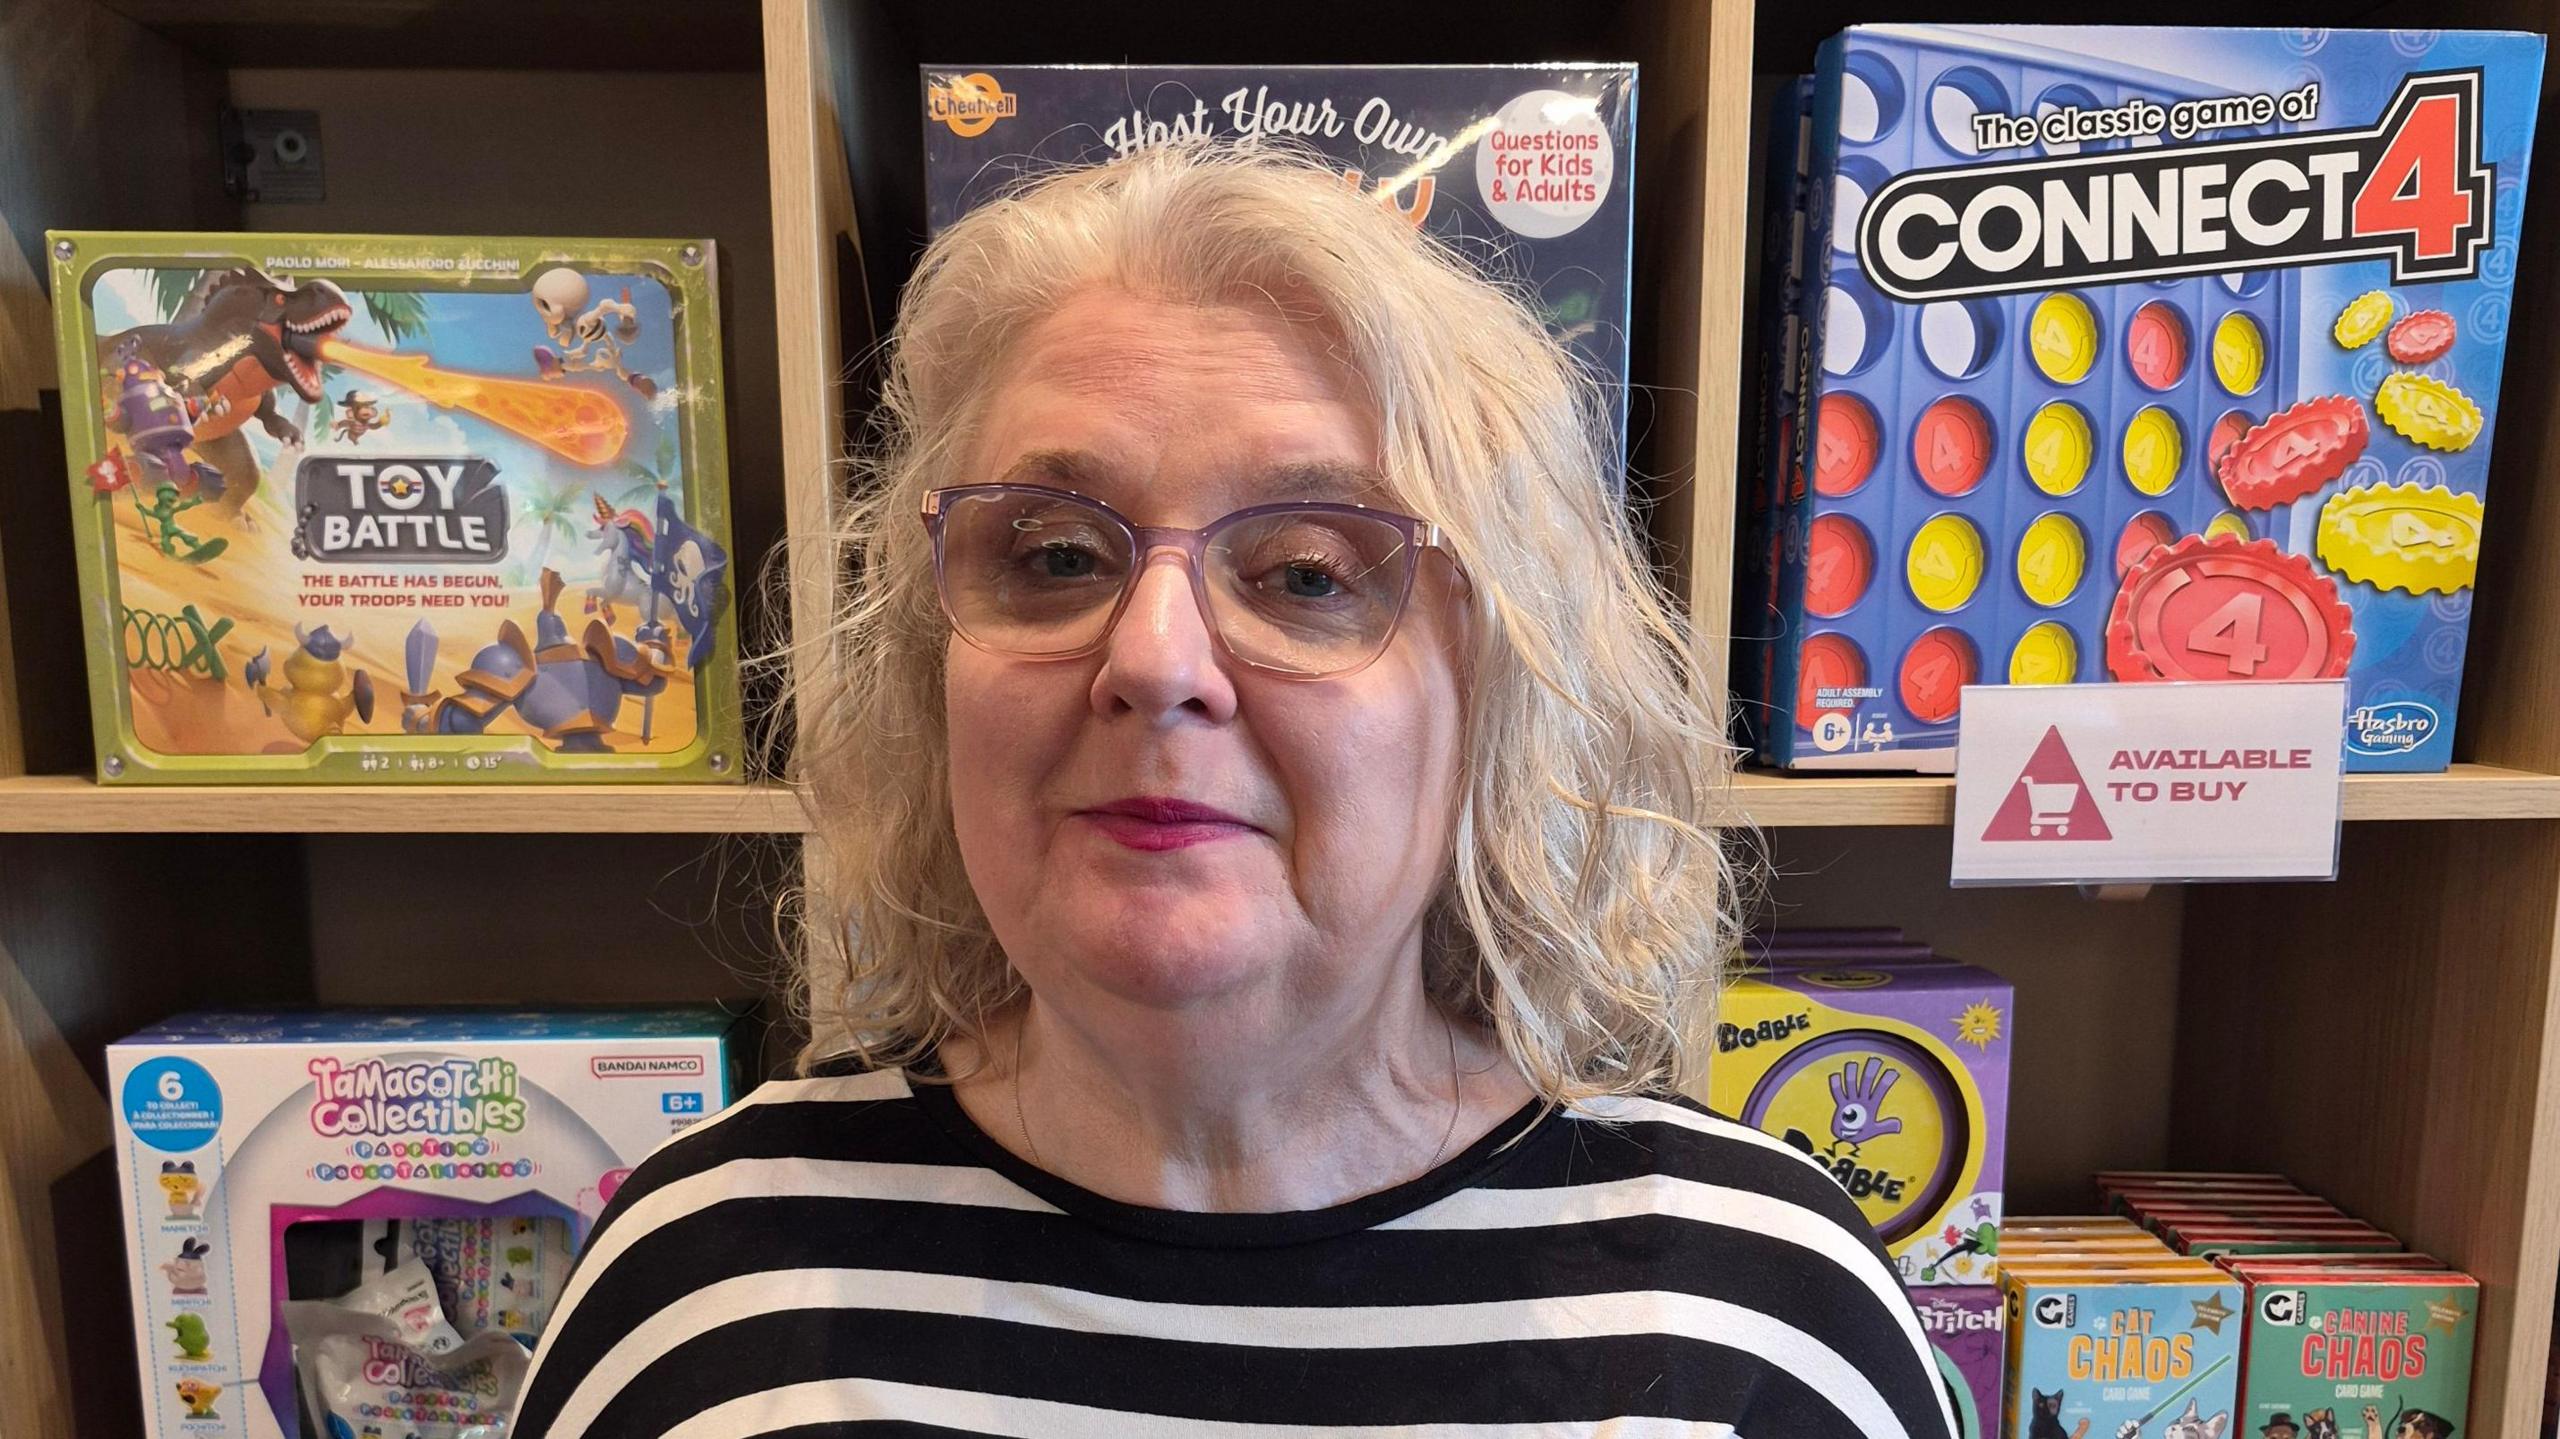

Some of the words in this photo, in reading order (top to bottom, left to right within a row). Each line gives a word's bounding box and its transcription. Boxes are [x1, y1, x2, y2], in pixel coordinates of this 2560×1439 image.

[934, 96, 1014, 116] Cheatwell
[1974, 113, 2037, 150] The
[2042, 100, 2166, 144] classic
[2170, 94, 2275, 140] game
[2278, 83, 2319, 120] of
[1105, 99, 1213, 162] Host
[1221, 85, 1345, 152] Your
[1353, 97, 1450, 160] Own
[1491, 130, 1599, 151] Questions
[1495, 154, 1533, 176] for
[1540, 153, 1593, 176] Kids
[1492, 179, 1508, 202] &
[1516, 179, 1596, 202] Adults
[1878, 151, 2360, 281] CONNECT
[2352, 93, 2472, 260] 4
[266, 257, 312, 269] PAOLO
[363, 258, 452, 271] ALESSANDRO
[458, 258, 520, 272] ZUCCHINI
[336, 464, 465, 511] TOY
[322, 514, 492, 552] BATTLE
[302, 575, 334, 588] THE
[338, 575, 399, 588] BATTLE
[404, 575, 438, 588] HAS
[443, 575, 504, 589] BEGUN,
[298, 594, 345, 607] YOUR
[349, 594, 417, 607] TROOPS
[421, 594, 465, 607] NEED
[471, 594, 510, 608] YOU!
[1816, 688, 1841, 698] ADULT
[1842, 688, 1883, 698] ASSEMBLY
[1823, 722, 1846, 741] 6+
[2357, 710, 2429, 735] Hasbro
[2360, 729, 2415, 749] Gaming
[2108, 749, 2313, 770] AVAILABLE
[2107, 782, 2159, 802] TO
[2169, 781, 2248, 802] BUY
[1716, 1012, 1811, 1054] DOBBLE
[598, 1061, 647, 1072] BANDAI
[649, 1060, 698, 1071] NAMCO
[158, 1070, 184, 1101] 6
[669, 1095, 697, 1111] 6+
[311, 1098, 527, 1138] Collectibles
[2066, 1295, 2076, 1328] GAMES
[2296, 1292, 2306, 1324] GAMES
[2111, 1307, 2154, 1337] CAT
[2323, 1308, 2408, 1336] CANINE
[2068, 1332, 2194, 1384] CHAOS
[2301, 1333, 2426, 1382] CHAOS
[2103, 1387, 2125, 1401] CARD
[2127, 1386, 2152, 1401] GAME
[2335, 1384, 2358, 1399] CARD
[2360, 1384, 2385, 1399] GAME
